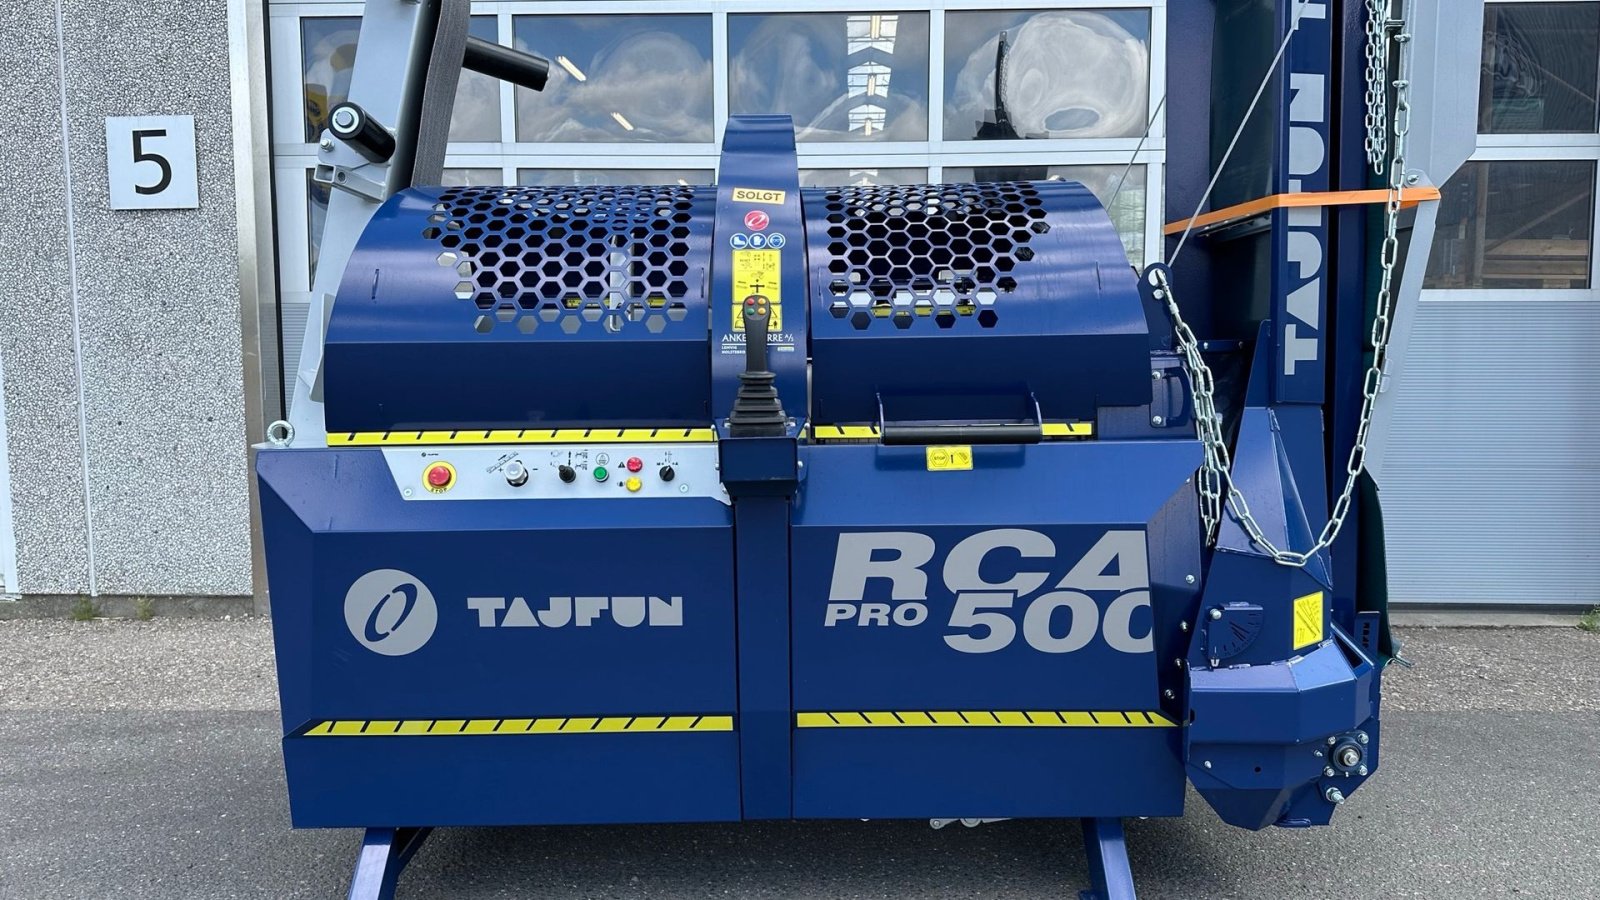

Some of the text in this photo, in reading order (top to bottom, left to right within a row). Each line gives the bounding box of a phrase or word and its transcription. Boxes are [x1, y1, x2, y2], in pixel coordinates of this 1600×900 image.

[132, 129, 172, 195] 5
[736, 190, 782, 201] SOLGT
[828, 528, 1149, 598] RCA
[466, 596, 683, 628] TAJFUN
[824, 590, 1154, 654] PRO 500
